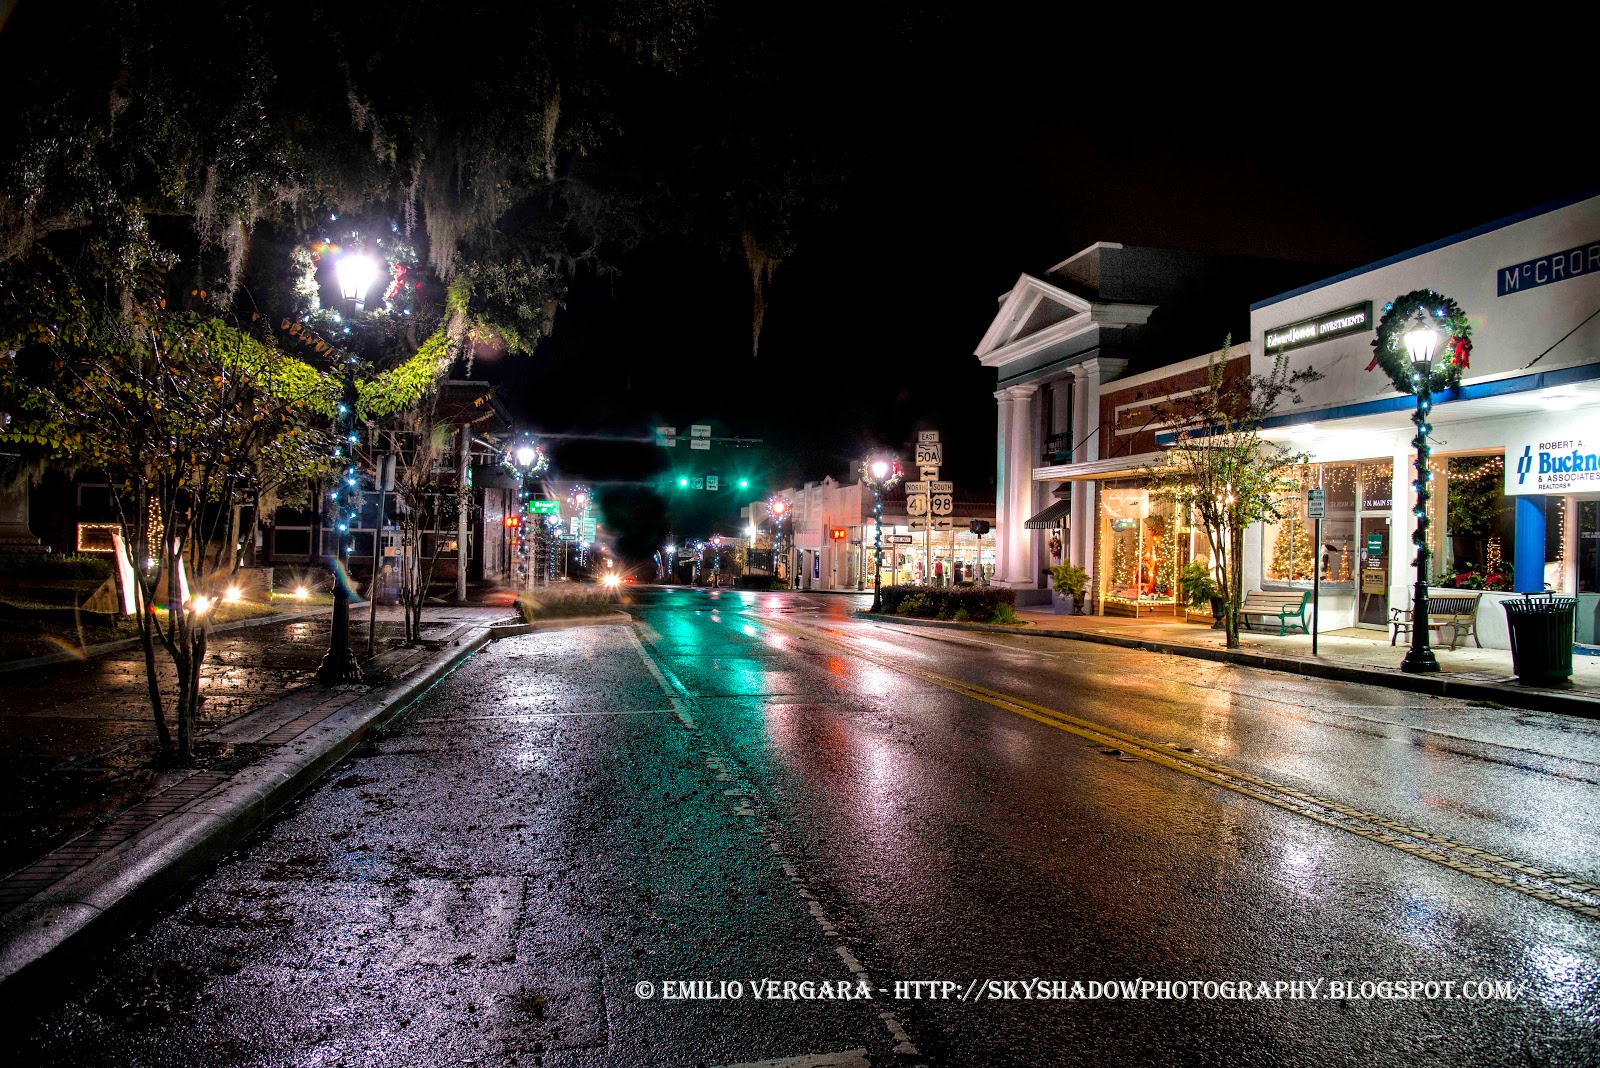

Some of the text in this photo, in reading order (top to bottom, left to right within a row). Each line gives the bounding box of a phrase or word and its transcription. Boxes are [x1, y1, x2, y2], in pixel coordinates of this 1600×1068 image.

[1320, 313, 1365, 334] INVESTMENTS
[921, 433, 936, 441] EAST
[1539, 439, 1586, 450] ROBERT A.
[917, 451, 938, 463] 50A
[1537, 472, 1600, 483] & ASSOCIATES
[909, 498, 923, 511] 41
[934, 498, 951, 511] 98
[1373, 499, 1387, 507] MAIN
